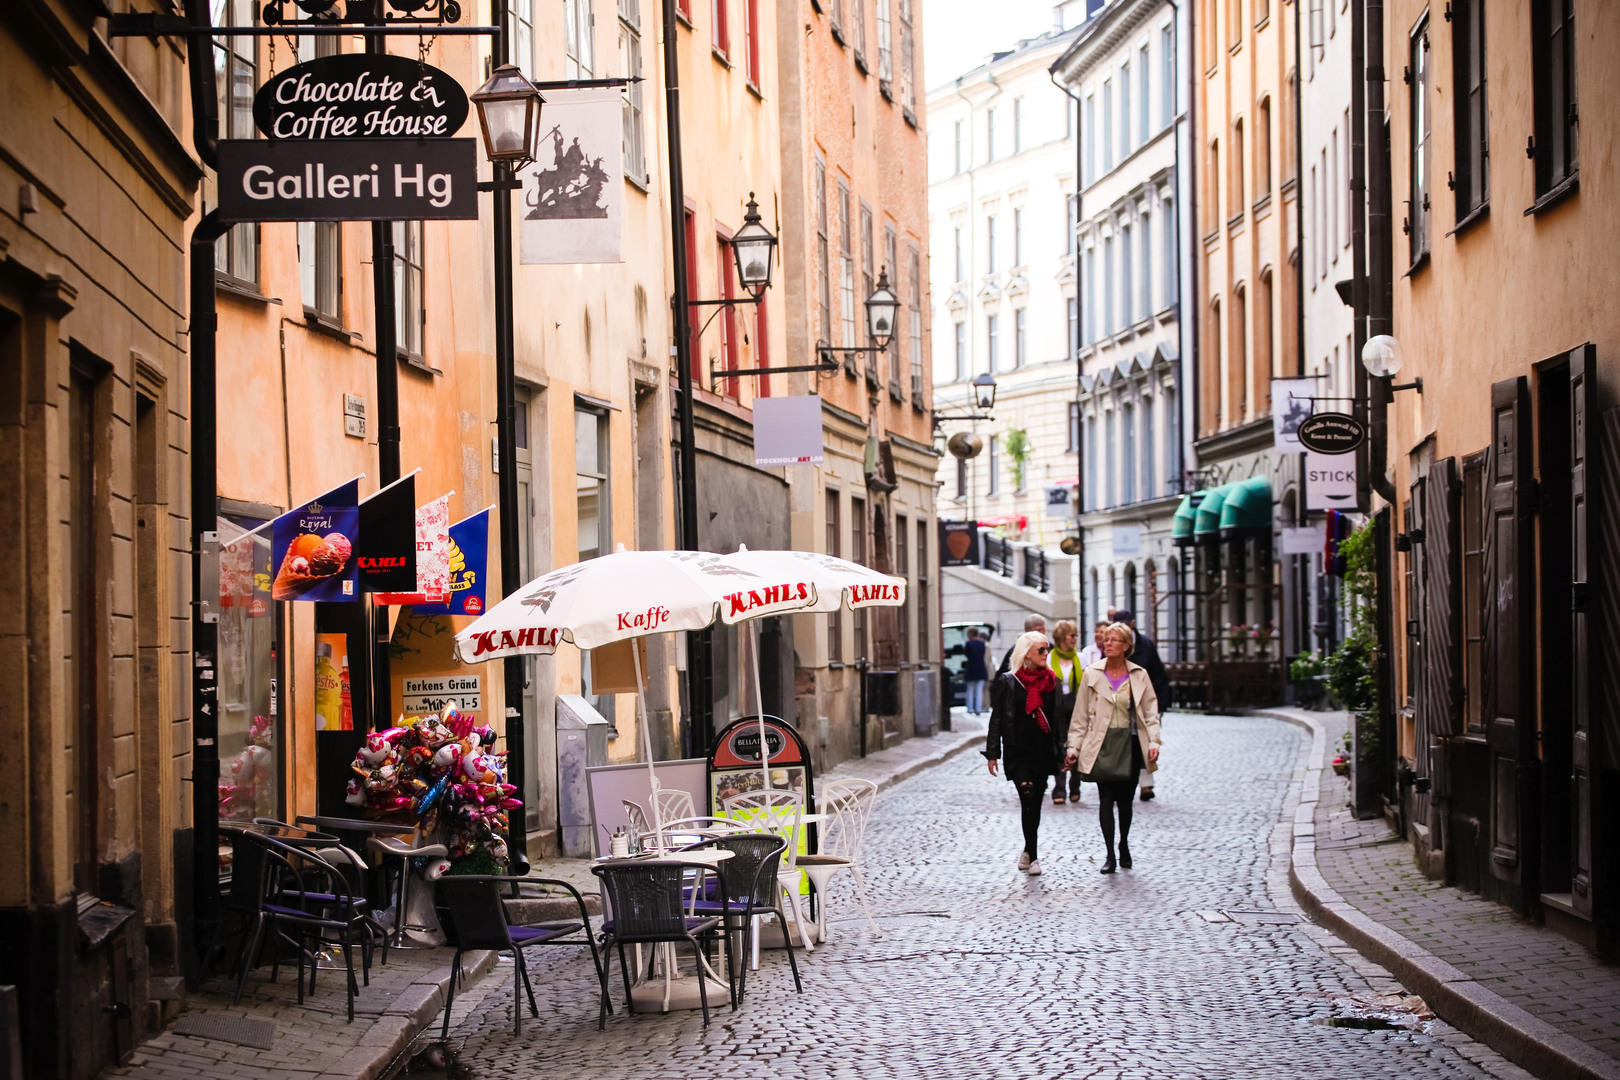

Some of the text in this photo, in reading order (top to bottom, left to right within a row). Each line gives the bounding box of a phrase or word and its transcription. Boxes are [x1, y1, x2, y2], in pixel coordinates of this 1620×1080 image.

[275, 71, 446, 108] Chocolate &
[272, 105, 448, 139] Coffee House
[242, 163, 453, 208] Galleri Hg
[1309, 470, 1355, 482] STICK
[299, 515, 333, 532] Royal
[357, 556, 406, 569] KAHLS
[723, 582, 808, 617] KAHLS
[848, 584, 900, 604] KAHLS
[617, 605, 670, 631] Kaffe
[470, 627, 559, 656] KAHLS
[406, 678, 477, 691] Ferkens Gränd
[460, 698, 478, 709] 1-5
